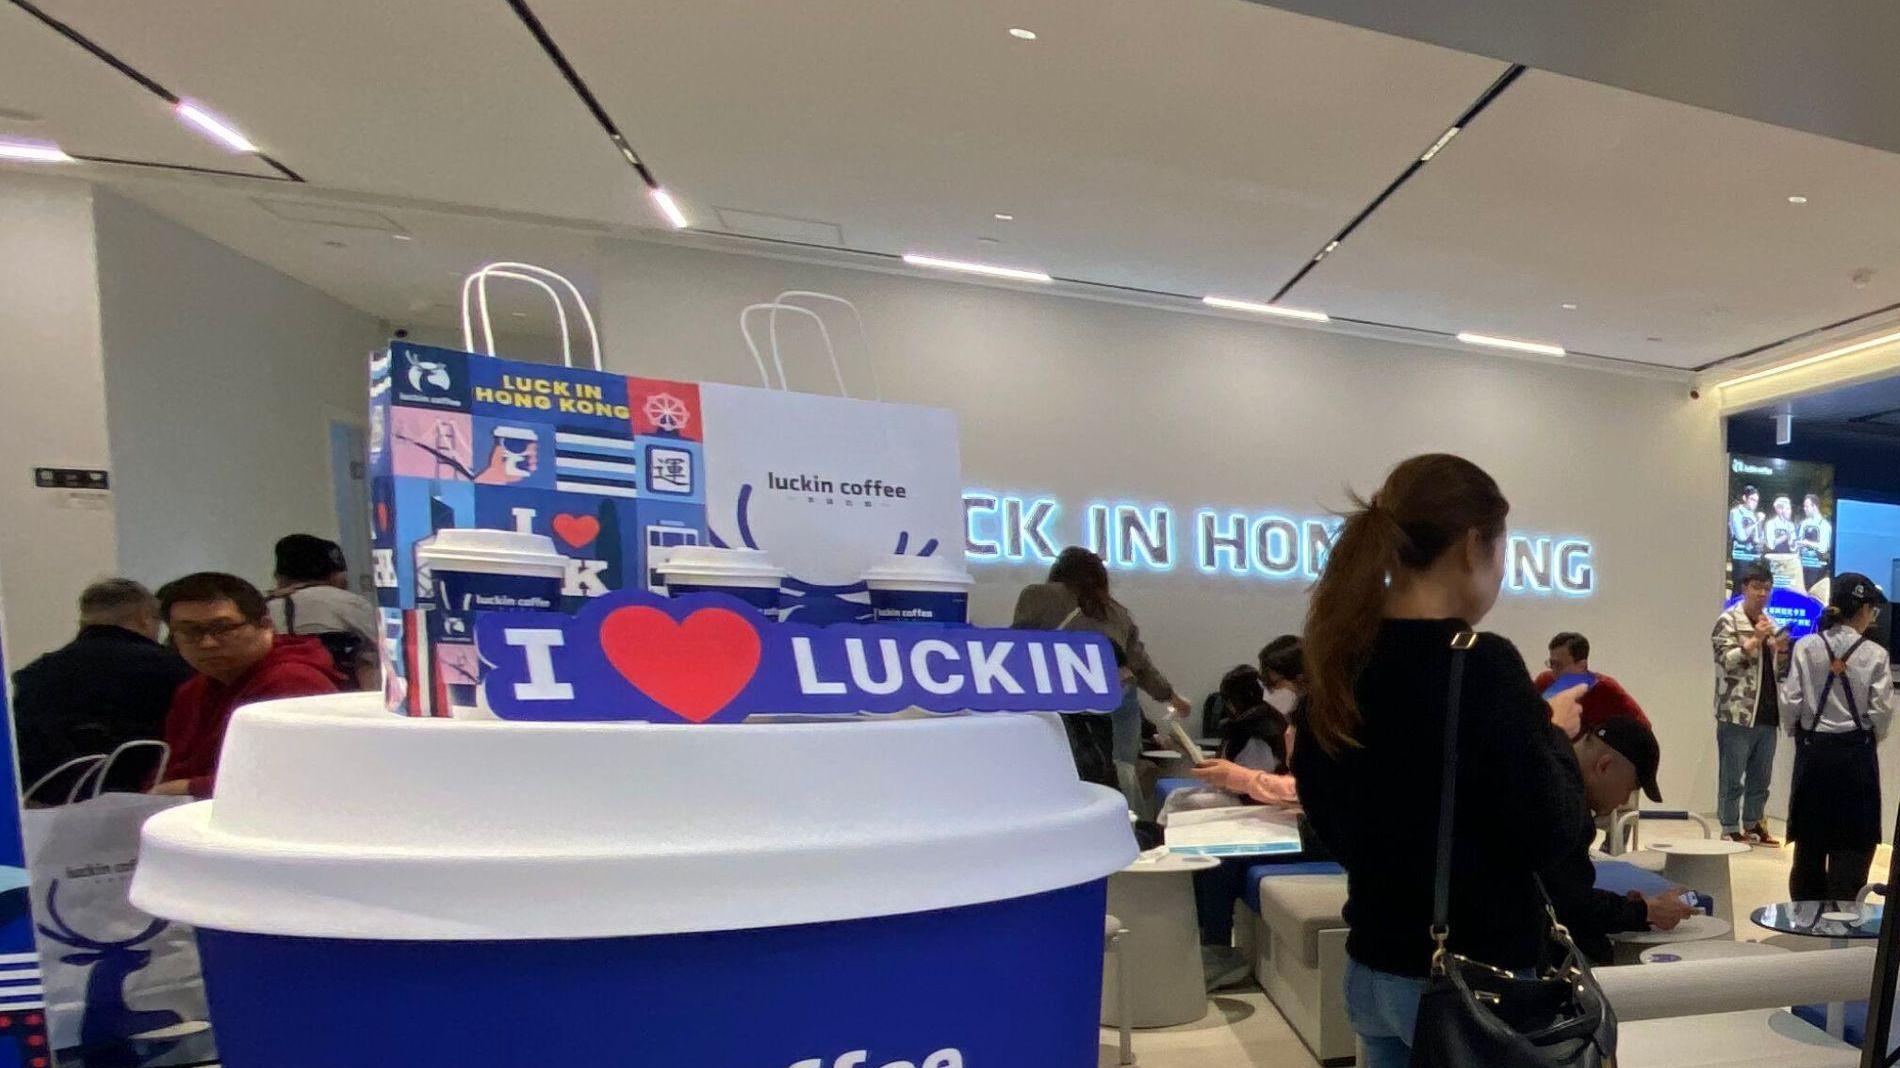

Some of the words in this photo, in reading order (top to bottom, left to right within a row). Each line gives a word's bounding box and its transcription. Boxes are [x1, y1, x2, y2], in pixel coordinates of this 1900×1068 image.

[475, 386, 553, 410] HONG
[559, 398, 630, 419] KONG
[503, 375, 569, 398] LUCK
[575, 382, 602, 399] IN
[652, 457, 690, 486] 運
[768, 471, 834, 494] luckin
[840, 480, 907, 498] coffee
[962, 495, 1057, 560] CK
[1089, 505, 1172, 567] IN
[1199, 511, 1347, 578] HON
[1506, 536, 1593, 594] NG
[561, 559, 608, 598] K
[503, 628, 575, 700] I
[790, 636, 1109, 696] LUCKIN
